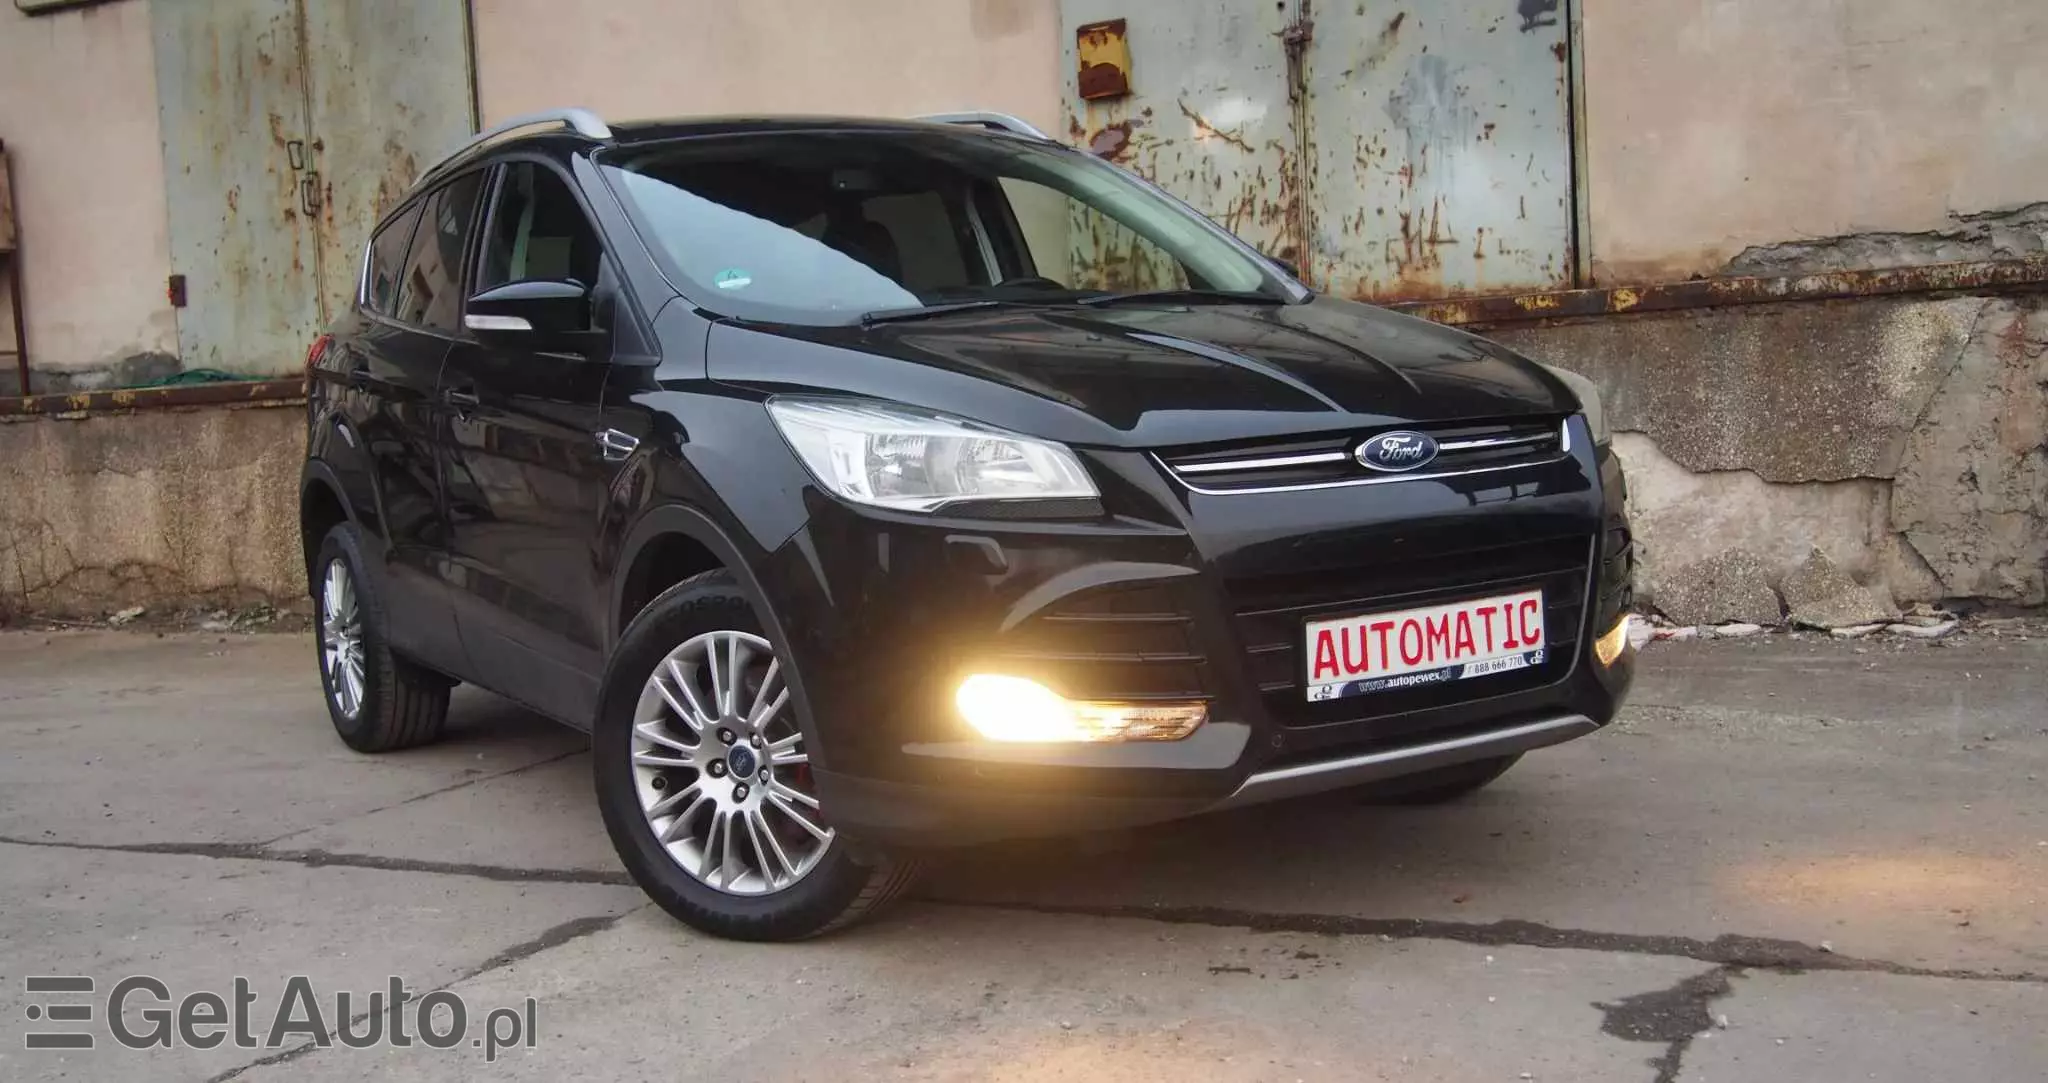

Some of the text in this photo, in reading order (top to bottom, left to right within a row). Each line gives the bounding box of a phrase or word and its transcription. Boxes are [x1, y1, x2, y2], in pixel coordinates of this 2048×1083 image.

[1379, 436, 1424, 460] Ford
[1313, 599, 1541, 679] AUTOMATIC
[1474, 662, 1490, 674] 888
[1492, 660, 1507, 671] 666
[1509, 656, 1523, 667] 770
